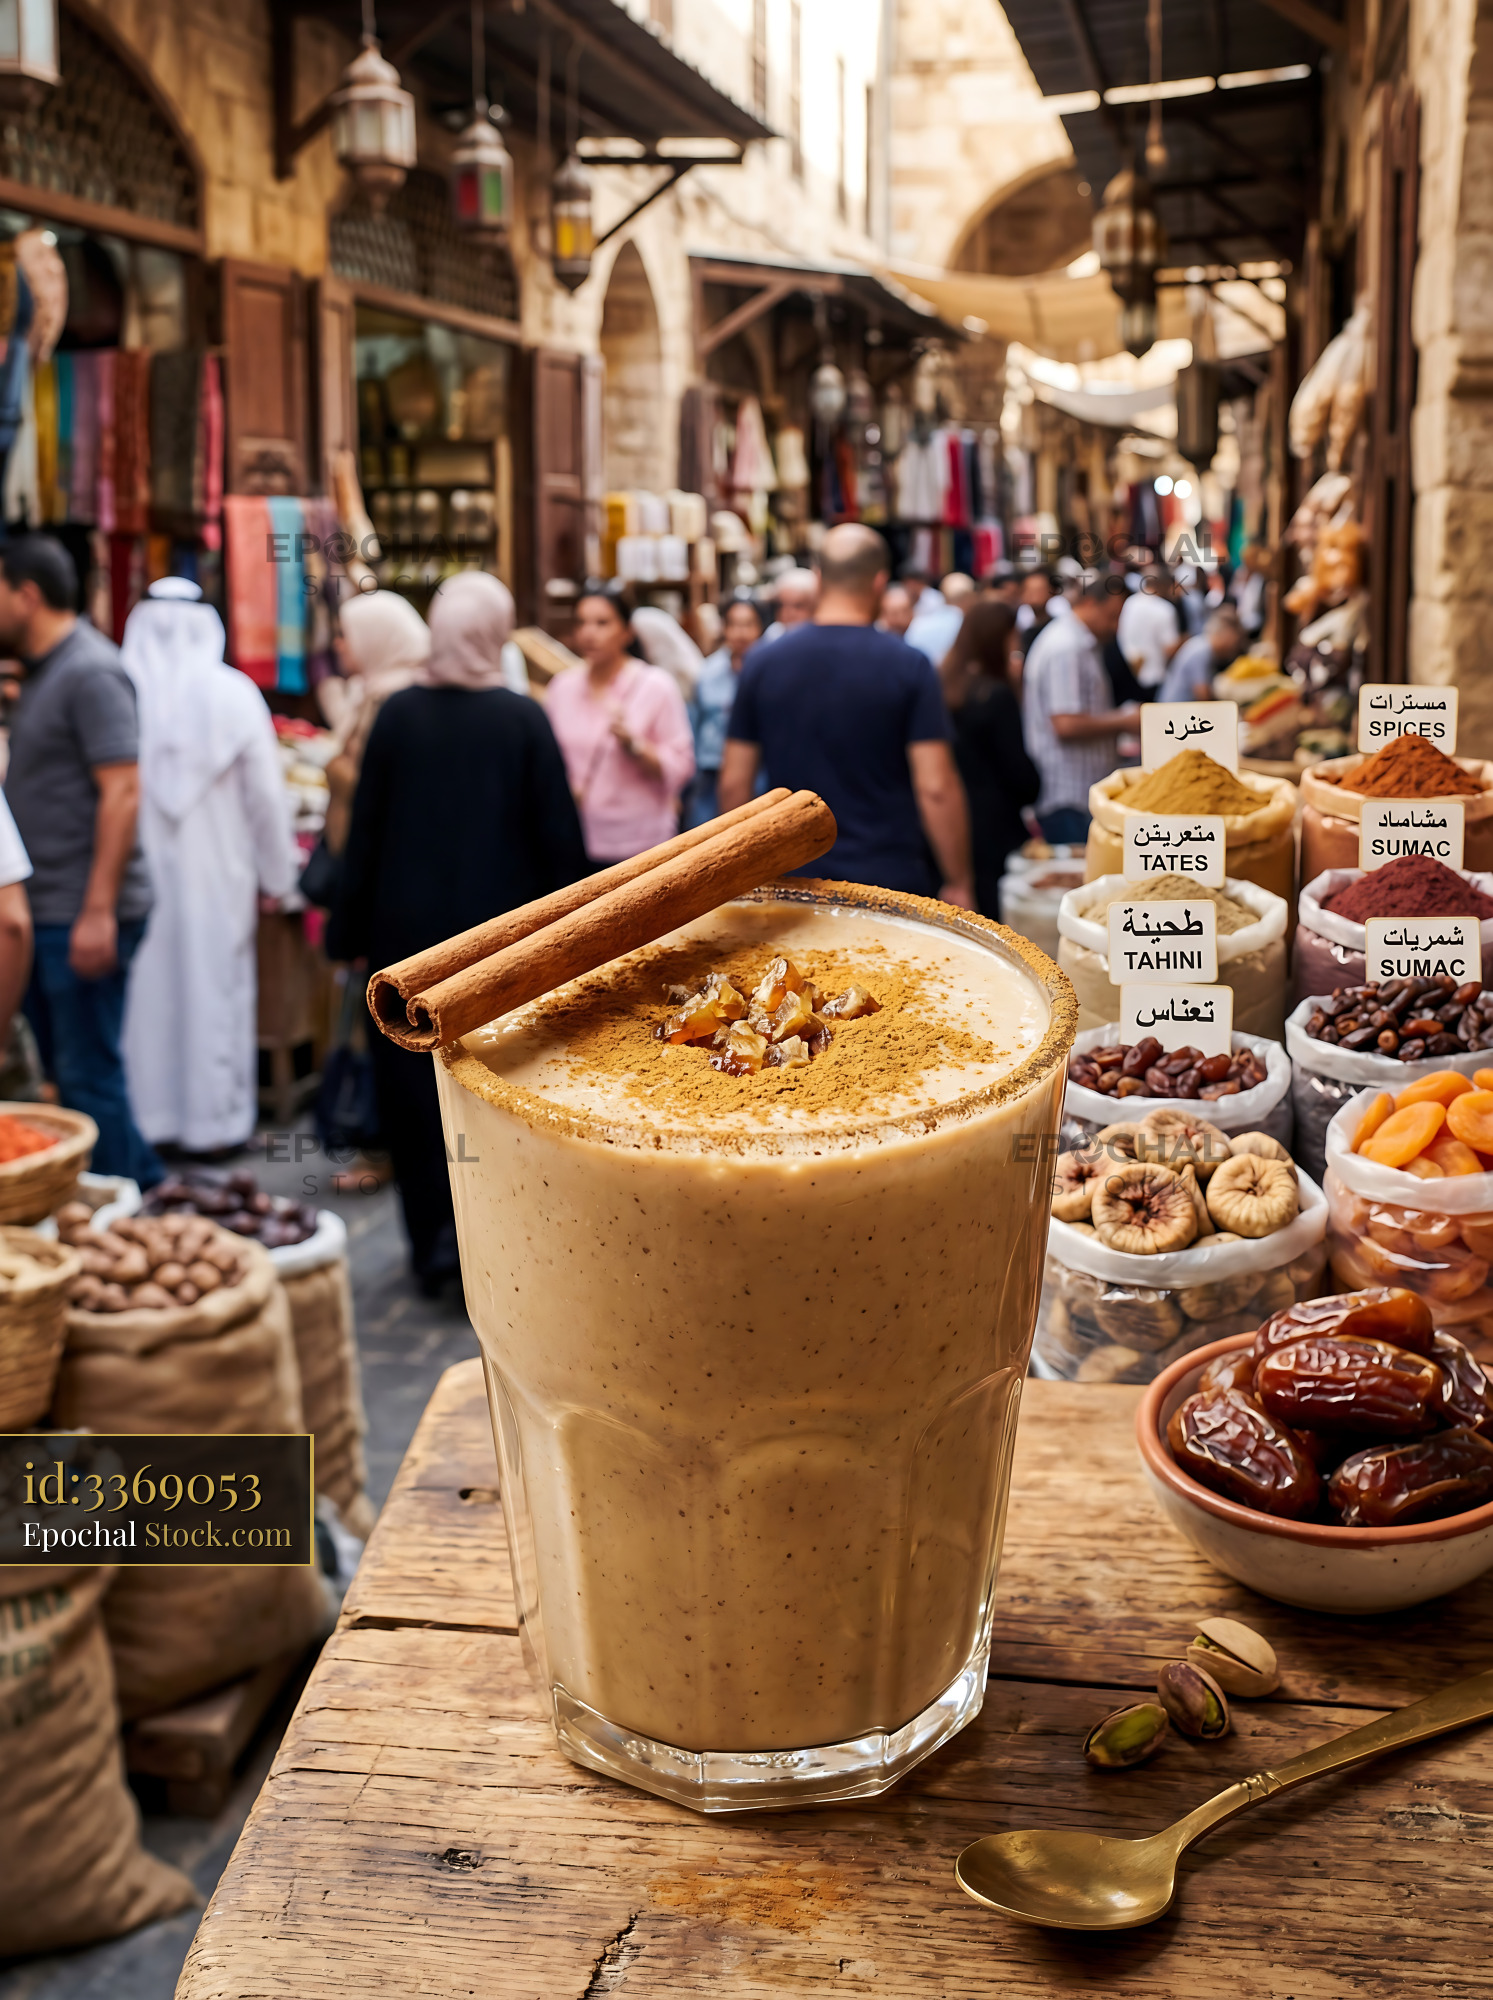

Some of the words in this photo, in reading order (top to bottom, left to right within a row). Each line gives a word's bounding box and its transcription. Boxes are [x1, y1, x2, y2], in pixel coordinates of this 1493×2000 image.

[1369, 720, 1446, 738] SPICES
[1371, 839, 1451, 857] SUMAC
[1139, 854, 1209, 872] TATES
[1122, 907, 1204, 945] طحينة
[1123, 950, 1202, 970] TAHINI
[1380, 958, 1466, 977] SUMAC
